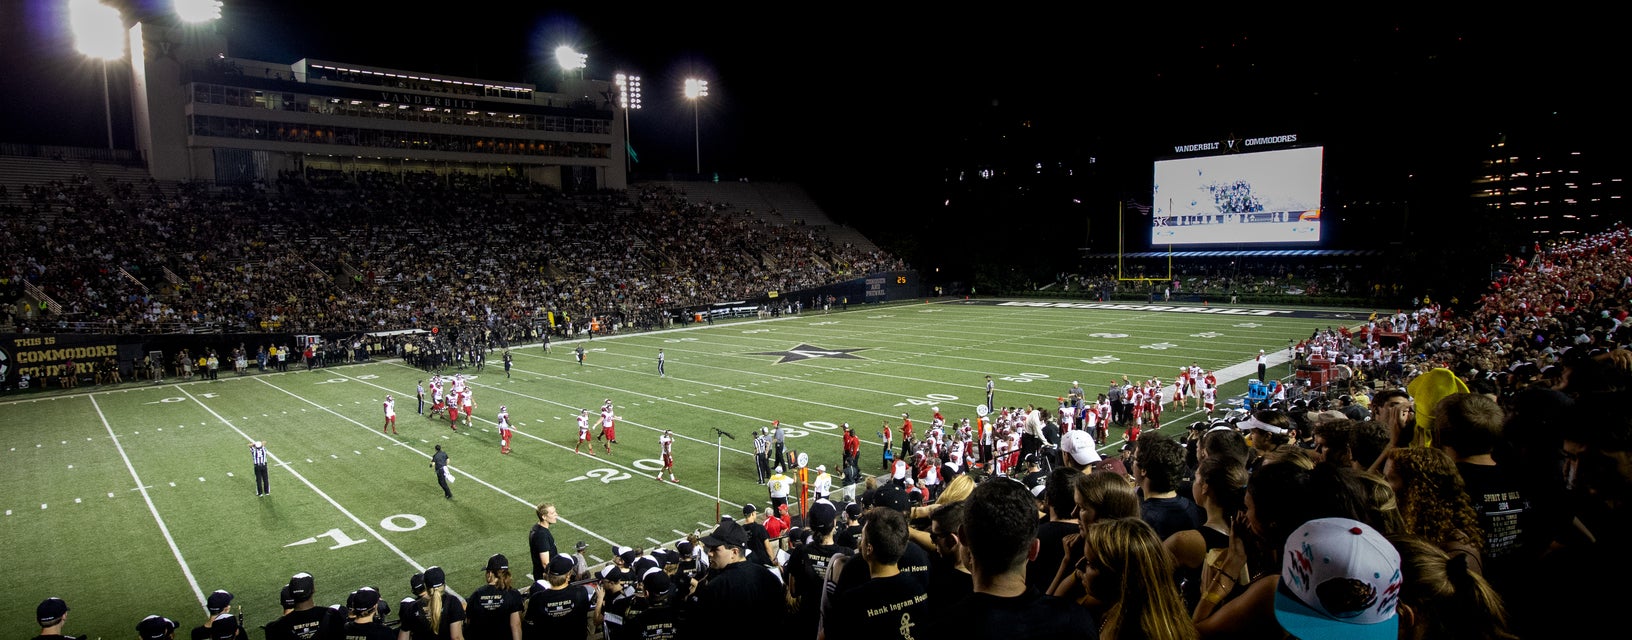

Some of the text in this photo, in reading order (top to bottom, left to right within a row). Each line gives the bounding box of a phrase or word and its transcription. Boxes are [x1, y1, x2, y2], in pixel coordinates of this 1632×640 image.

[382, 92, 475, 108] VANDERBILT
[1174, 134, 1297, 153] VANDERBILT V COMMODORES
[897, 276, 906, 284] 25
[14, 336, 56, 347] THIS IS
[17, 345, 117, 364] COMMODORE
[18, 361, 95, 378] CONRY
[867, 593, 928, 617] Hank Ingram Hous
